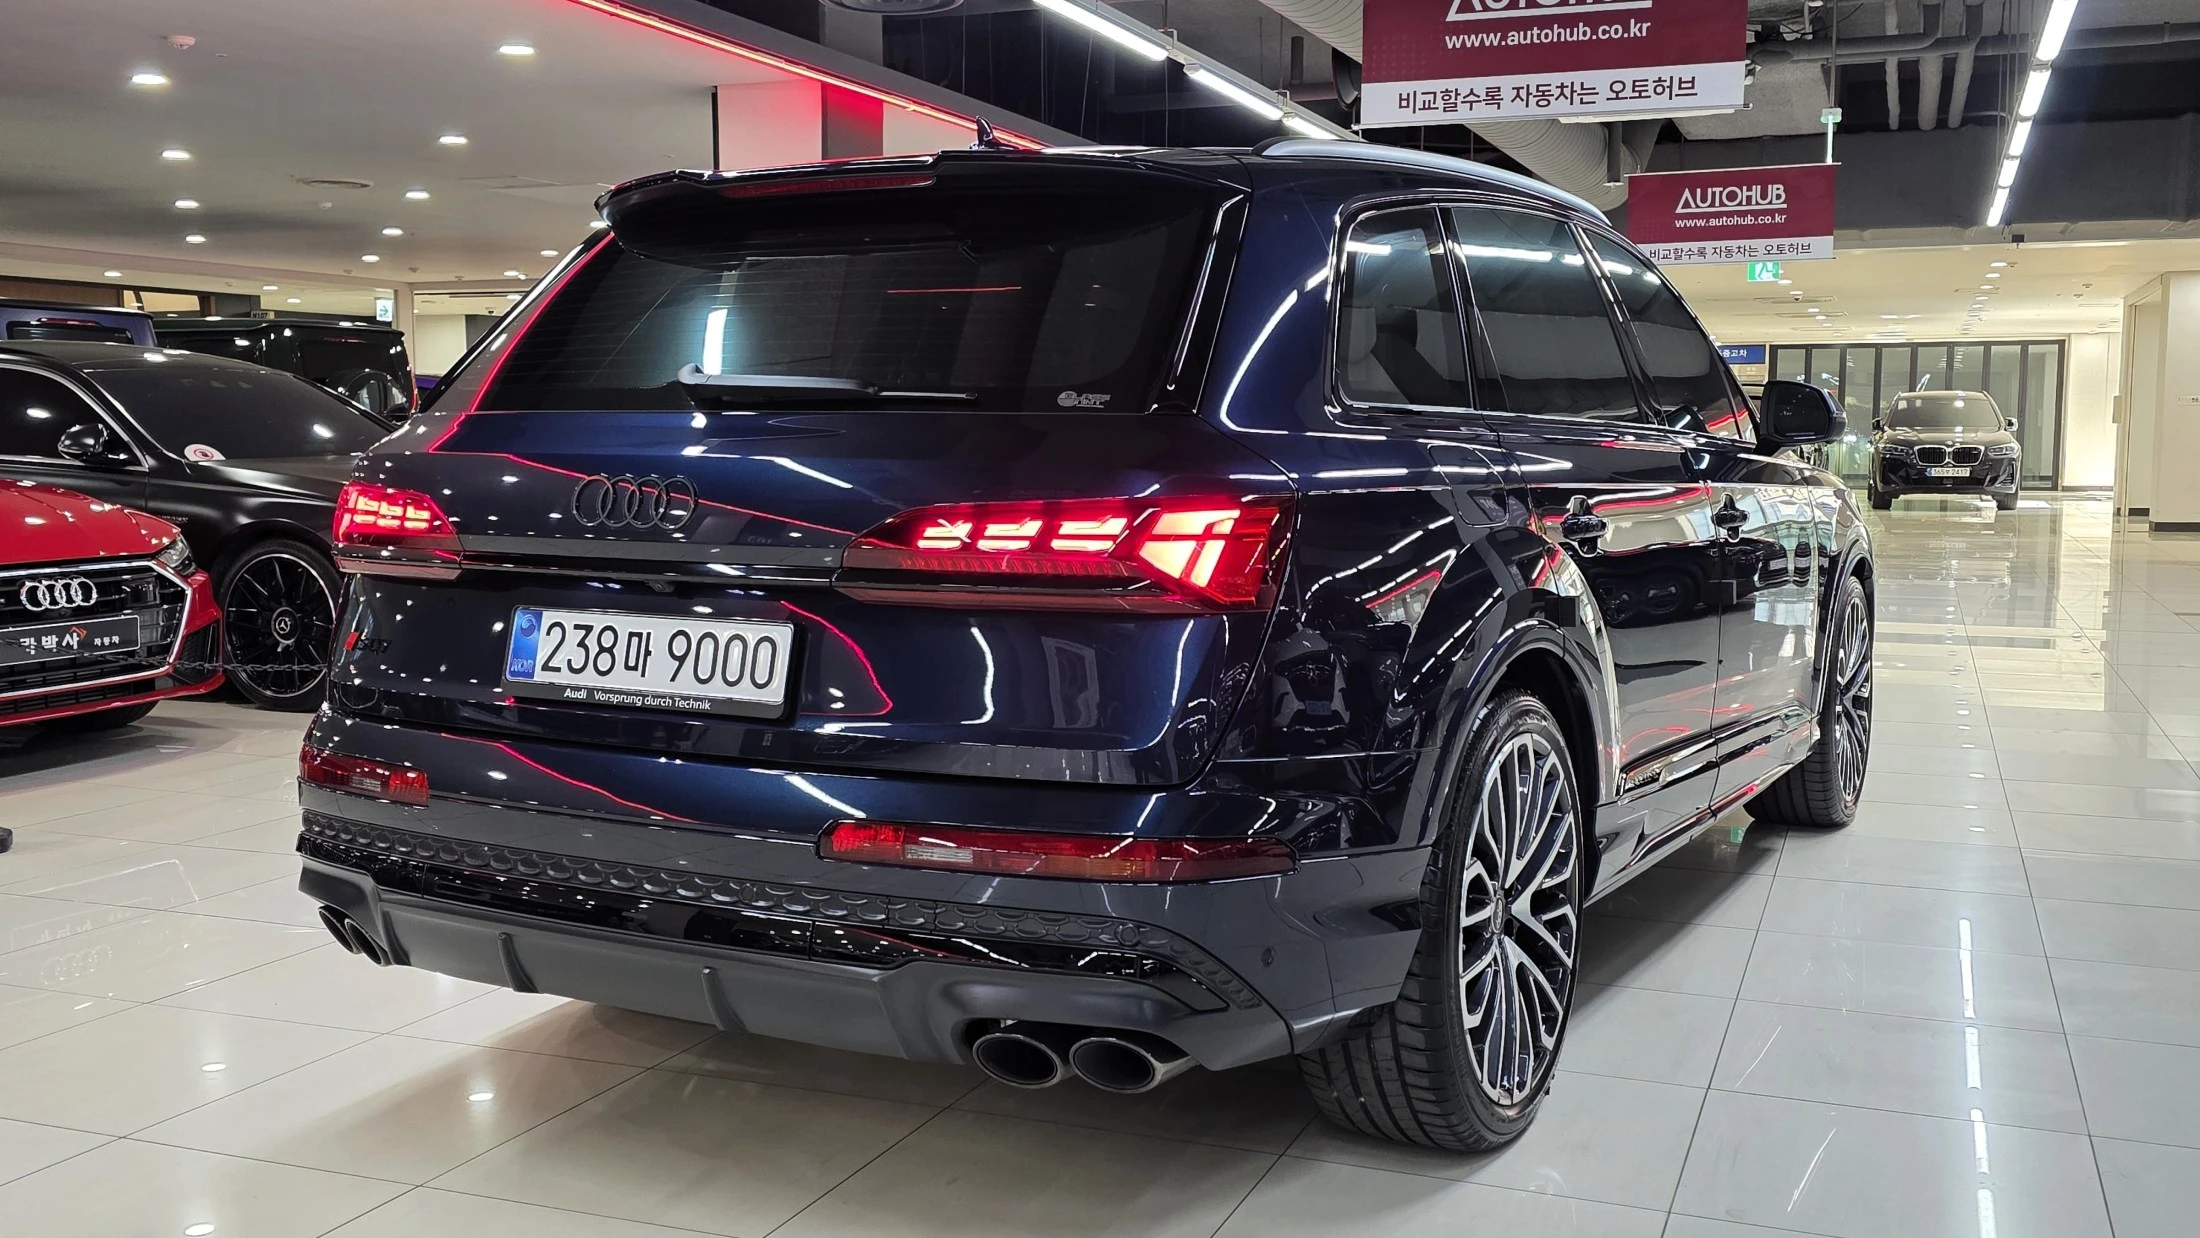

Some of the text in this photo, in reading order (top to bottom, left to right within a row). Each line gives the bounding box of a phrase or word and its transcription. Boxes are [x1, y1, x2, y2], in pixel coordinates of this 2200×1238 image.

[1445, 18, 1651, 49] www.autohub.co.kr
[1398, 75, 1698, 114] 비교할수록 자동차는 오토허브
[1675, 184, 1787, 213] AUTOHUB
[1675, 213, 1787, 227] www.autohub.co.kr
[1649, 242, 1812, 261] 비교할수록 자동차는 오토허브
[1719, 348, 1748, 359] 중고차
[511, 658, 534, 673] KOR
[540, 621, 777, 690] 238마 9000
[564, 688, 711, 711] Audi Vorsprung durch Technik
